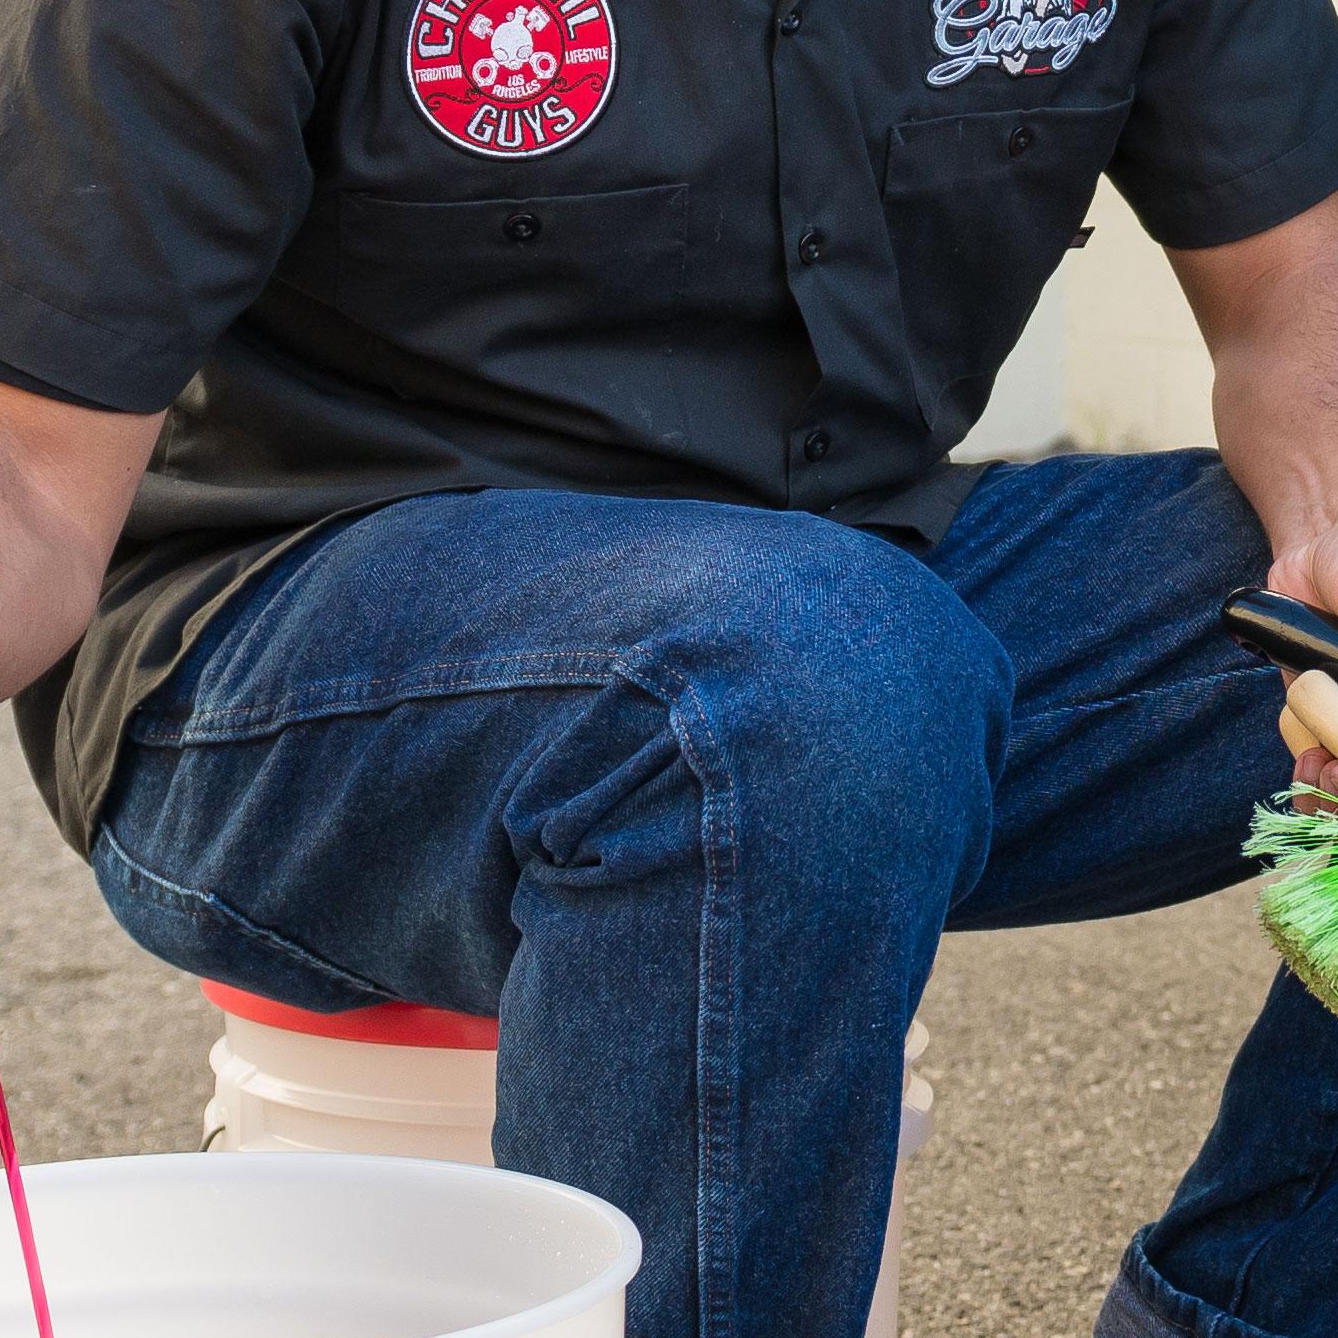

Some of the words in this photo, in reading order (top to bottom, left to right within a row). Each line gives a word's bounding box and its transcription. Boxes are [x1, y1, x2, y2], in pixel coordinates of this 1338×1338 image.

[564, 45, 610, 66] LIFESTYLE
[414, 64, 463, 84] TRADITION
[507, 74, 525, 86] LOS
[491, 79, 542, 98] ANGELES
[466, 96, 577, 148] GUYS
